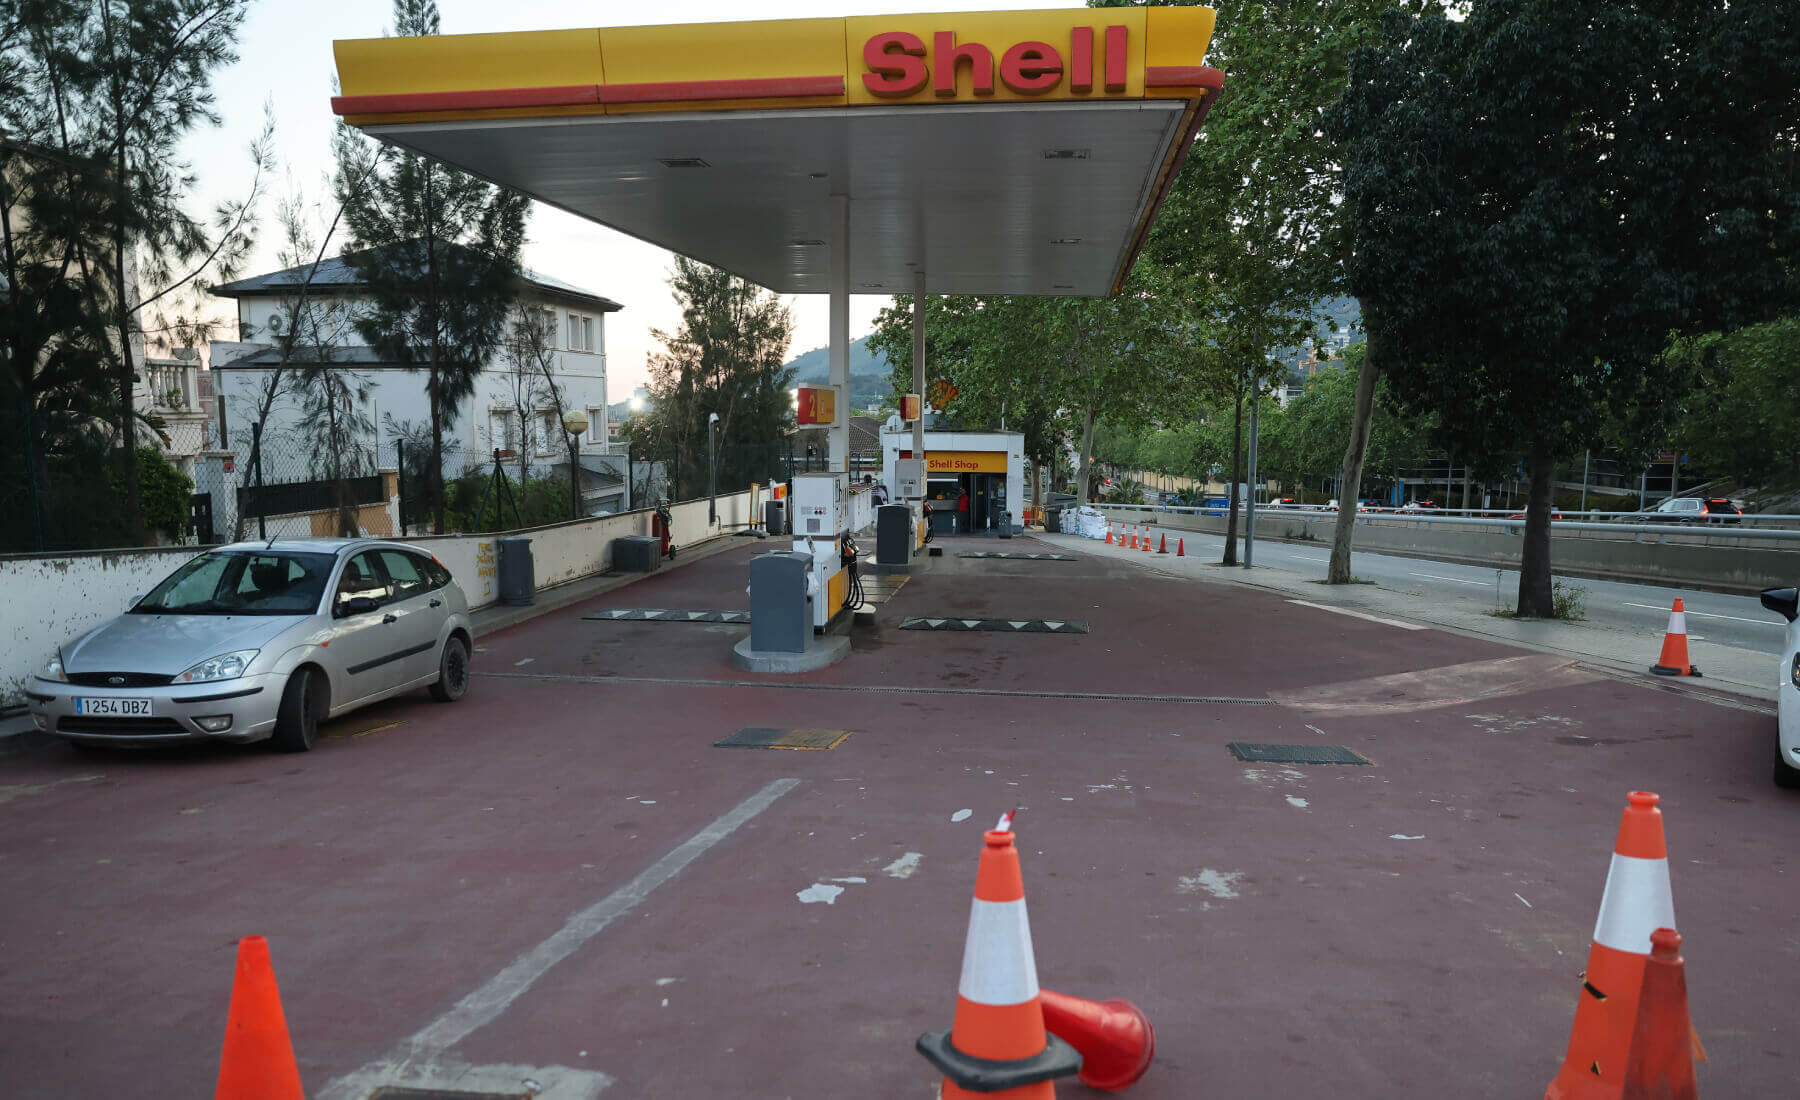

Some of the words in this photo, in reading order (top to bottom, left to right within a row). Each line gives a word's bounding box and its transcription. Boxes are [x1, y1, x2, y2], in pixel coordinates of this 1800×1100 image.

[861, 25, 1128, 97] Shell
[808, 393, 817, 417] 2
[929, 459, 952, 469] Shell
[954, 460, 979, 471] Shop
[85, 700, 118, 713] 1254
[121, 700, 150, 714] DBZ
